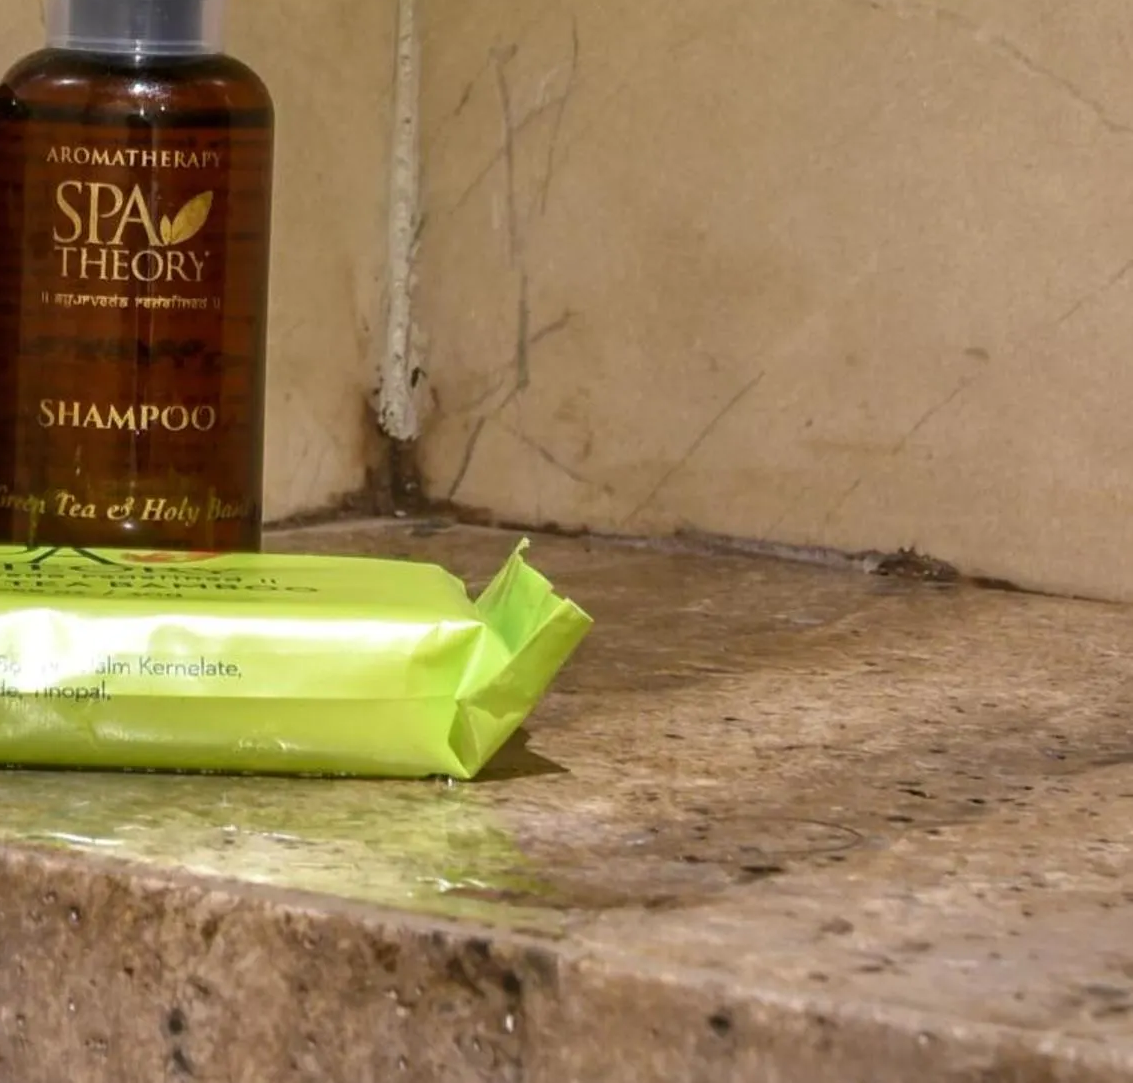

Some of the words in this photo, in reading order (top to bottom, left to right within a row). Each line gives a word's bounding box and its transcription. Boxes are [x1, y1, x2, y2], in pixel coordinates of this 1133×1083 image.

[47, 146, 221, 168] AROMATHERAPY
[52, 180, 166, 247] SPA
[54, 245, 205, 282] THEORY
[37, 398, 216, 432] SHAMPOO
[55, 490, 96, 518] Tea
[106, 495, 134, 520] &
[142, 496, 200, 526] Holy
[139, 655, 243, 679] Kernelate,
